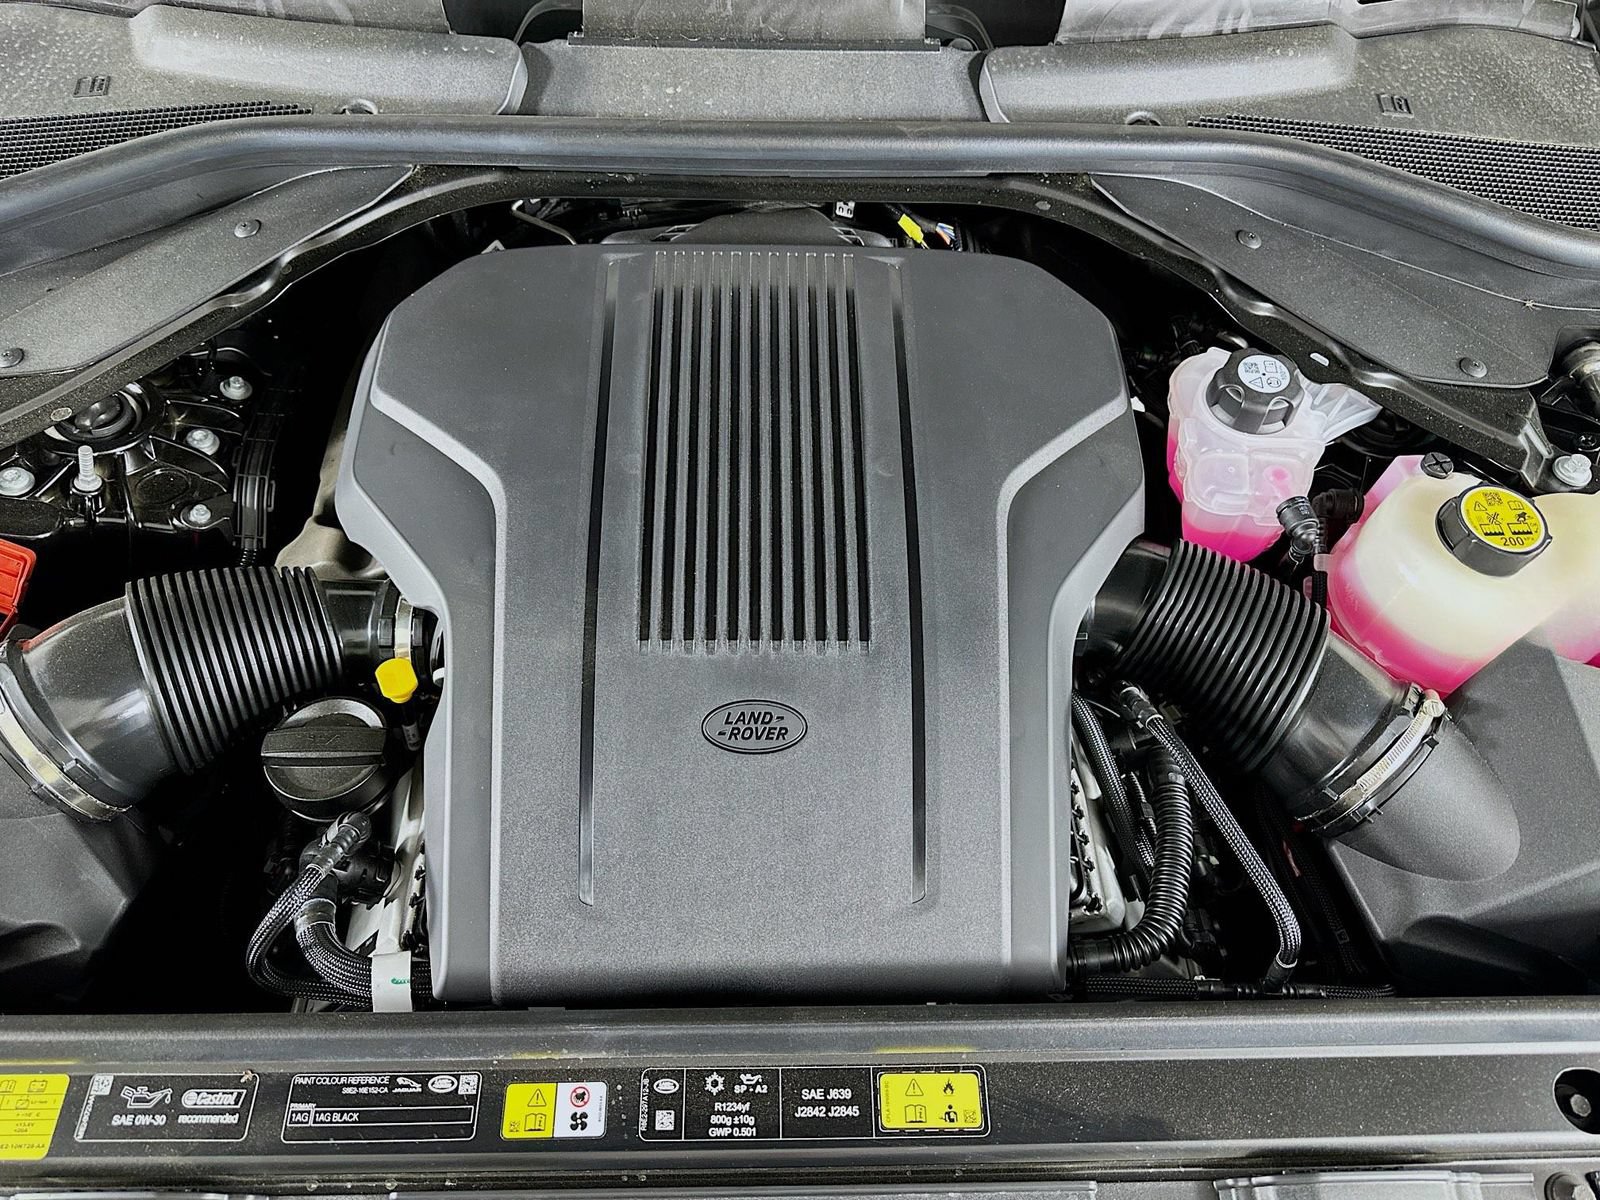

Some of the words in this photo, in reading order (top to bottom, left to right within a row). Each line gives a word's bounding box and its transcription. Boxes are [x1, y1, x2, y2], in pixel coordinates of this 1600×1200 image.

[1500, 536, 1524, 546] 200
[294, 1077, 316, 1085] PAINT
[316, 1076, 347, 1085] COLOUR
[348, 1076, 391, 1084] REFERENCE
[733, 1084, 747, 1094] SP
[754, 1084, 768, 1094] A2
[801, 1088, 825, 1100] SAE
[826, 1088, 852, 1100] J639
[196, 1092, 238, 1105] Castrol
[714, 1101, 751, 1113] R1234yf
[794, 1105, 826, 1118] J2842
[827, 1105, 860, 1117] J2845
[111, 1114, 135, 1126] SAE
[135, 1114, 167, 1126] 0W-30
[177, 1113, 239, 1124] recommended
[291, 1112, 309, 1122] 1AG
[315, 1112, 331, 1122] 1AG
[332, 1112, 359, 1122] BLACK
[710, 1114, 732, 1126] 800g
[732, 1114, 755, 1126] ±10g
[708, 1127, 732, 1137] GWP
[732, 1126, 756, 1137] 0.501
